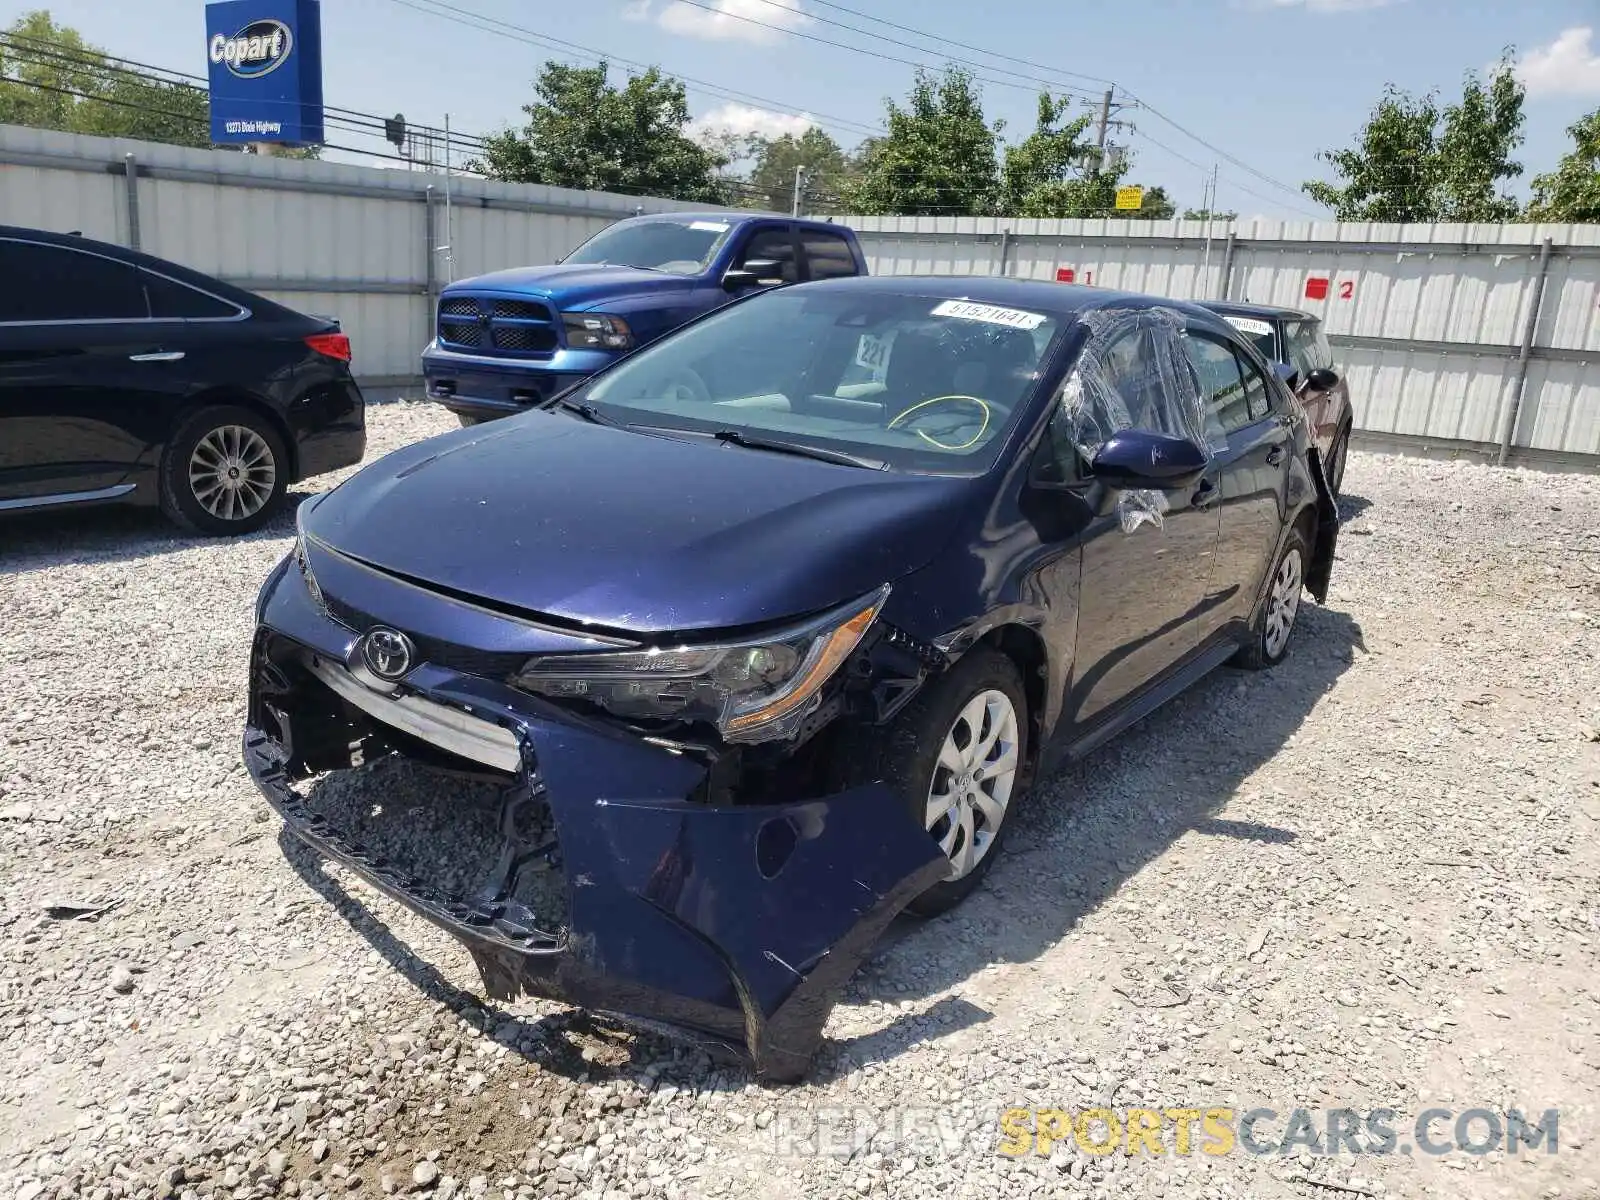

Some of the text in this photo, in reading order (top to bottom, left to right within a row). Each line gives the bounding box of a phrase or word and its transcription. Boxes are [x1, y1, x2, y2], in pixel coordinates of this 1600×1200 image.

[211, 31, 281, 68] Copart
[256, 120, 281, 134] Highway
[1340, 281, 1353, 299] 2
